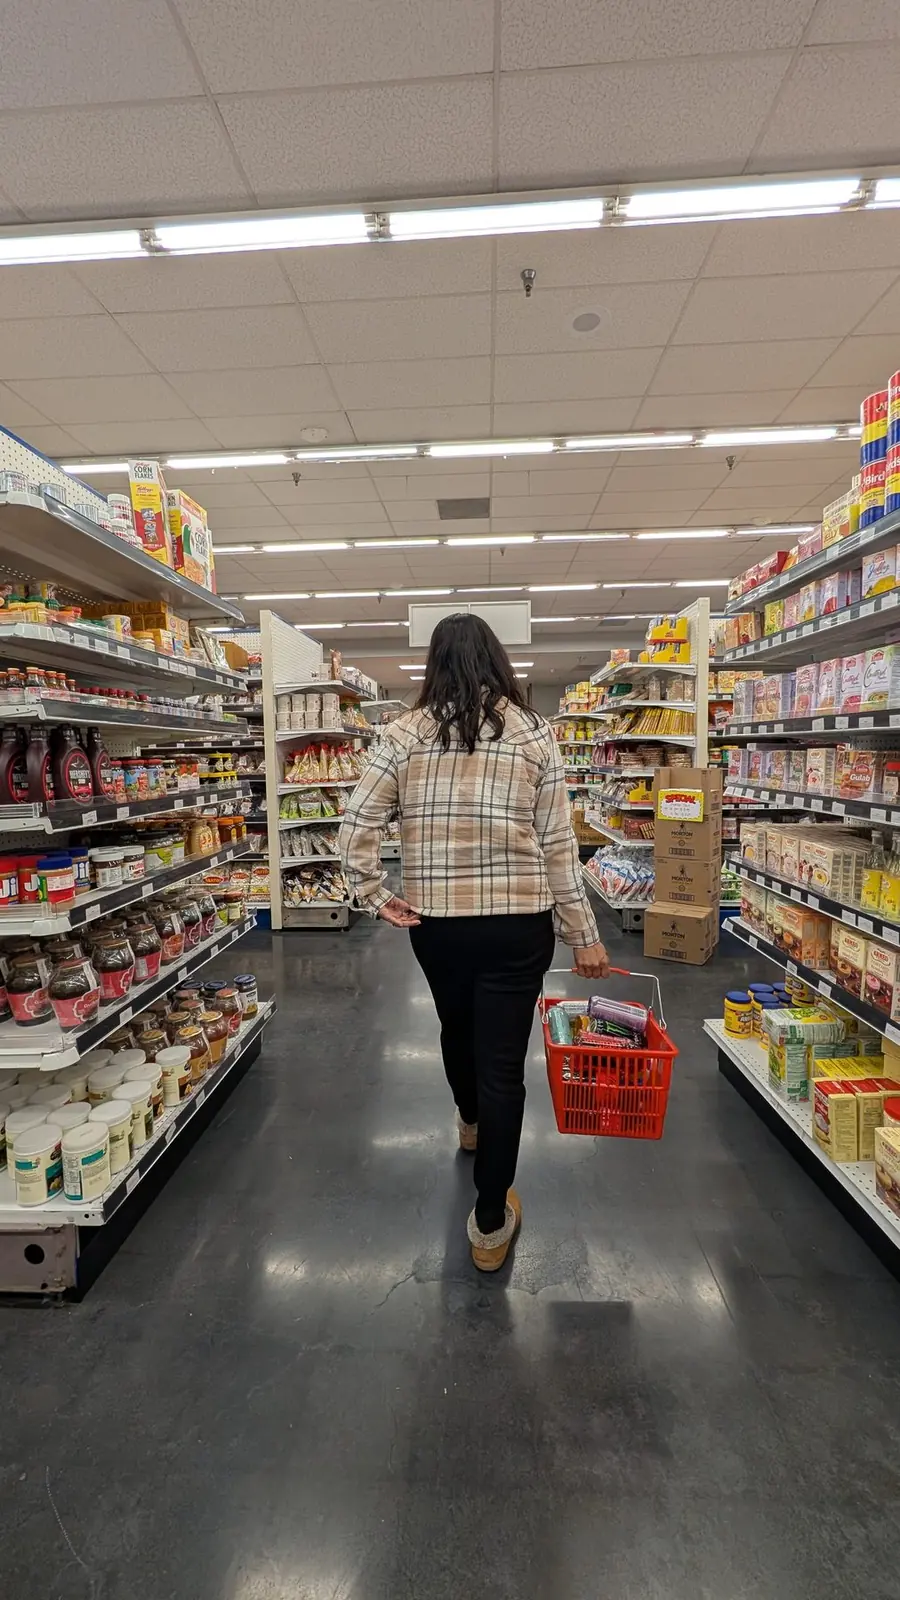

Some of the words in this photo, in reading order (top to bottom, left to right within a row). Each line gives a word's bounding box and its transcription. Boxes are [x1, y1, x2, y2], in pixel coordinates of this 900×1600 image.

[850, 773, 871, 782] Gulab
[665, 794, 696, 804] SPECIAL
[671, 830, 693, 838] MORTON
[662, 931, 686, 939] MORTON
